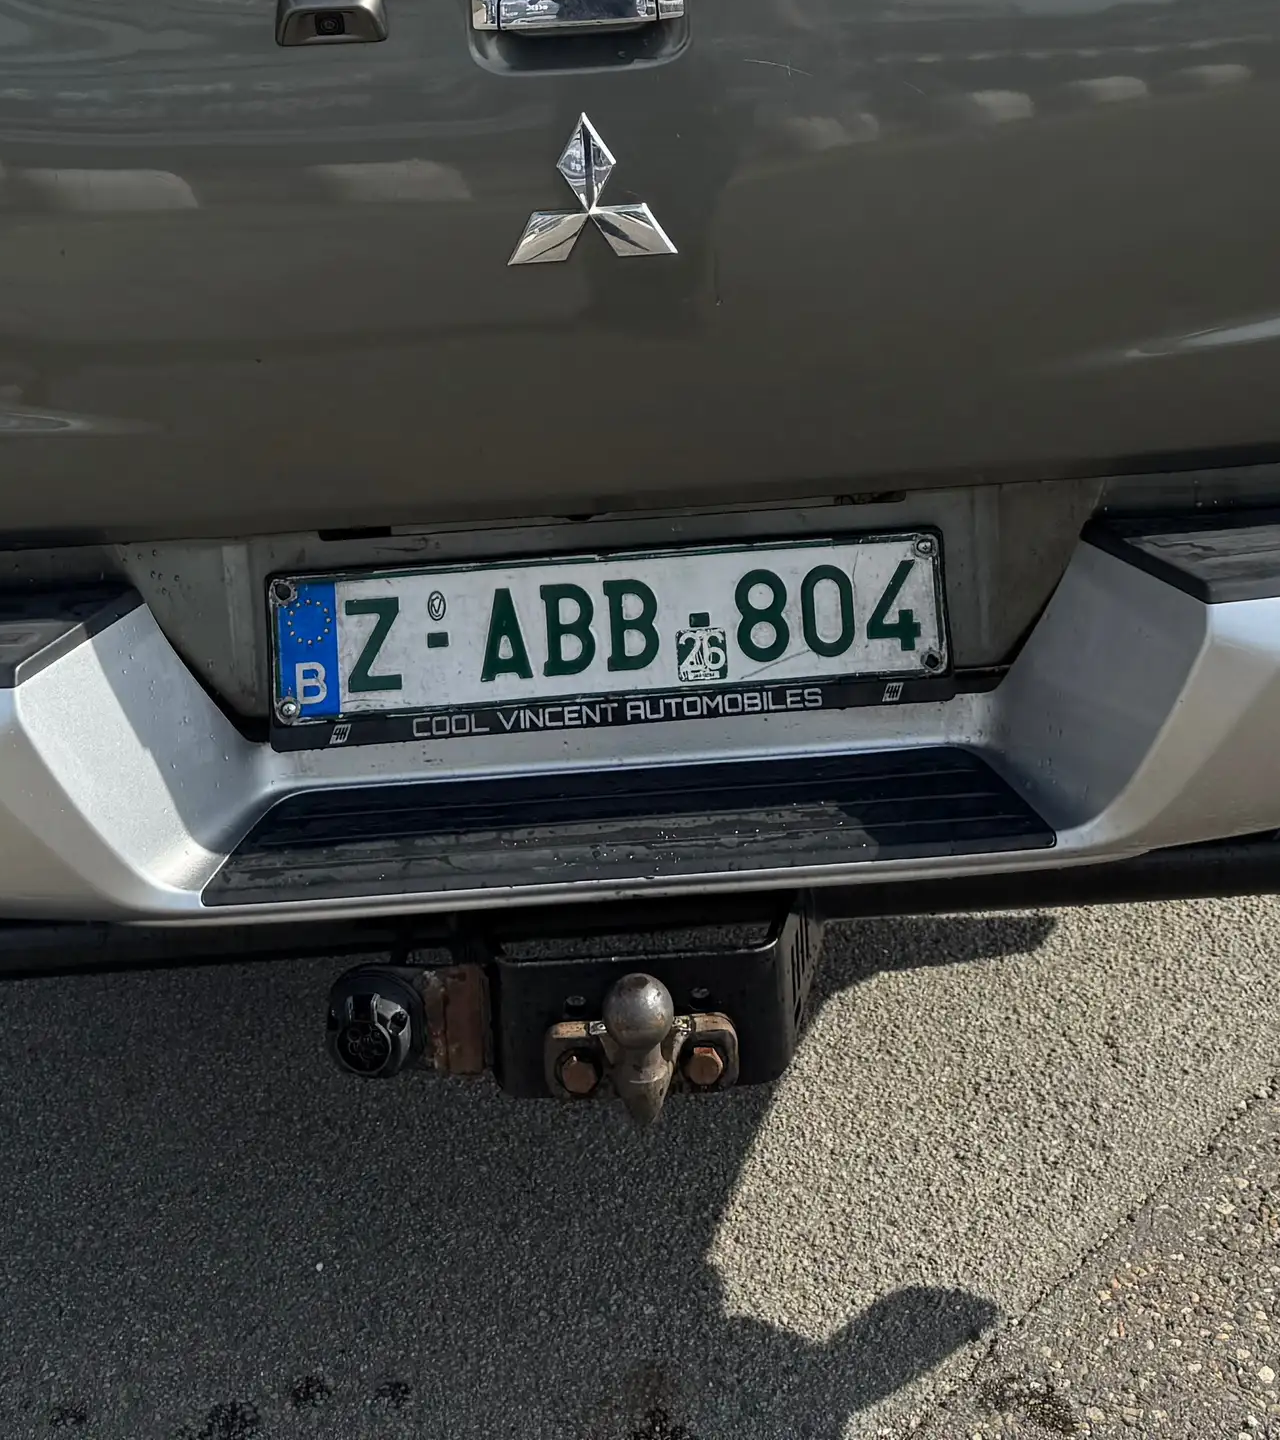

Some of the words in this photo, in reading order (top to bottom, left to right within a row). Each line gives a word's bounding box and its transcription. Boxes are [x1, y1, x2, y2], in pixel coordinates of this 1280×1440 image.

[295, 662, 327, 705] B
[412, 714, 490, 738] COOL
[497, 702, 618, 730] VINCENT
[626, 688, 823, 721] AUTOMOBILES
